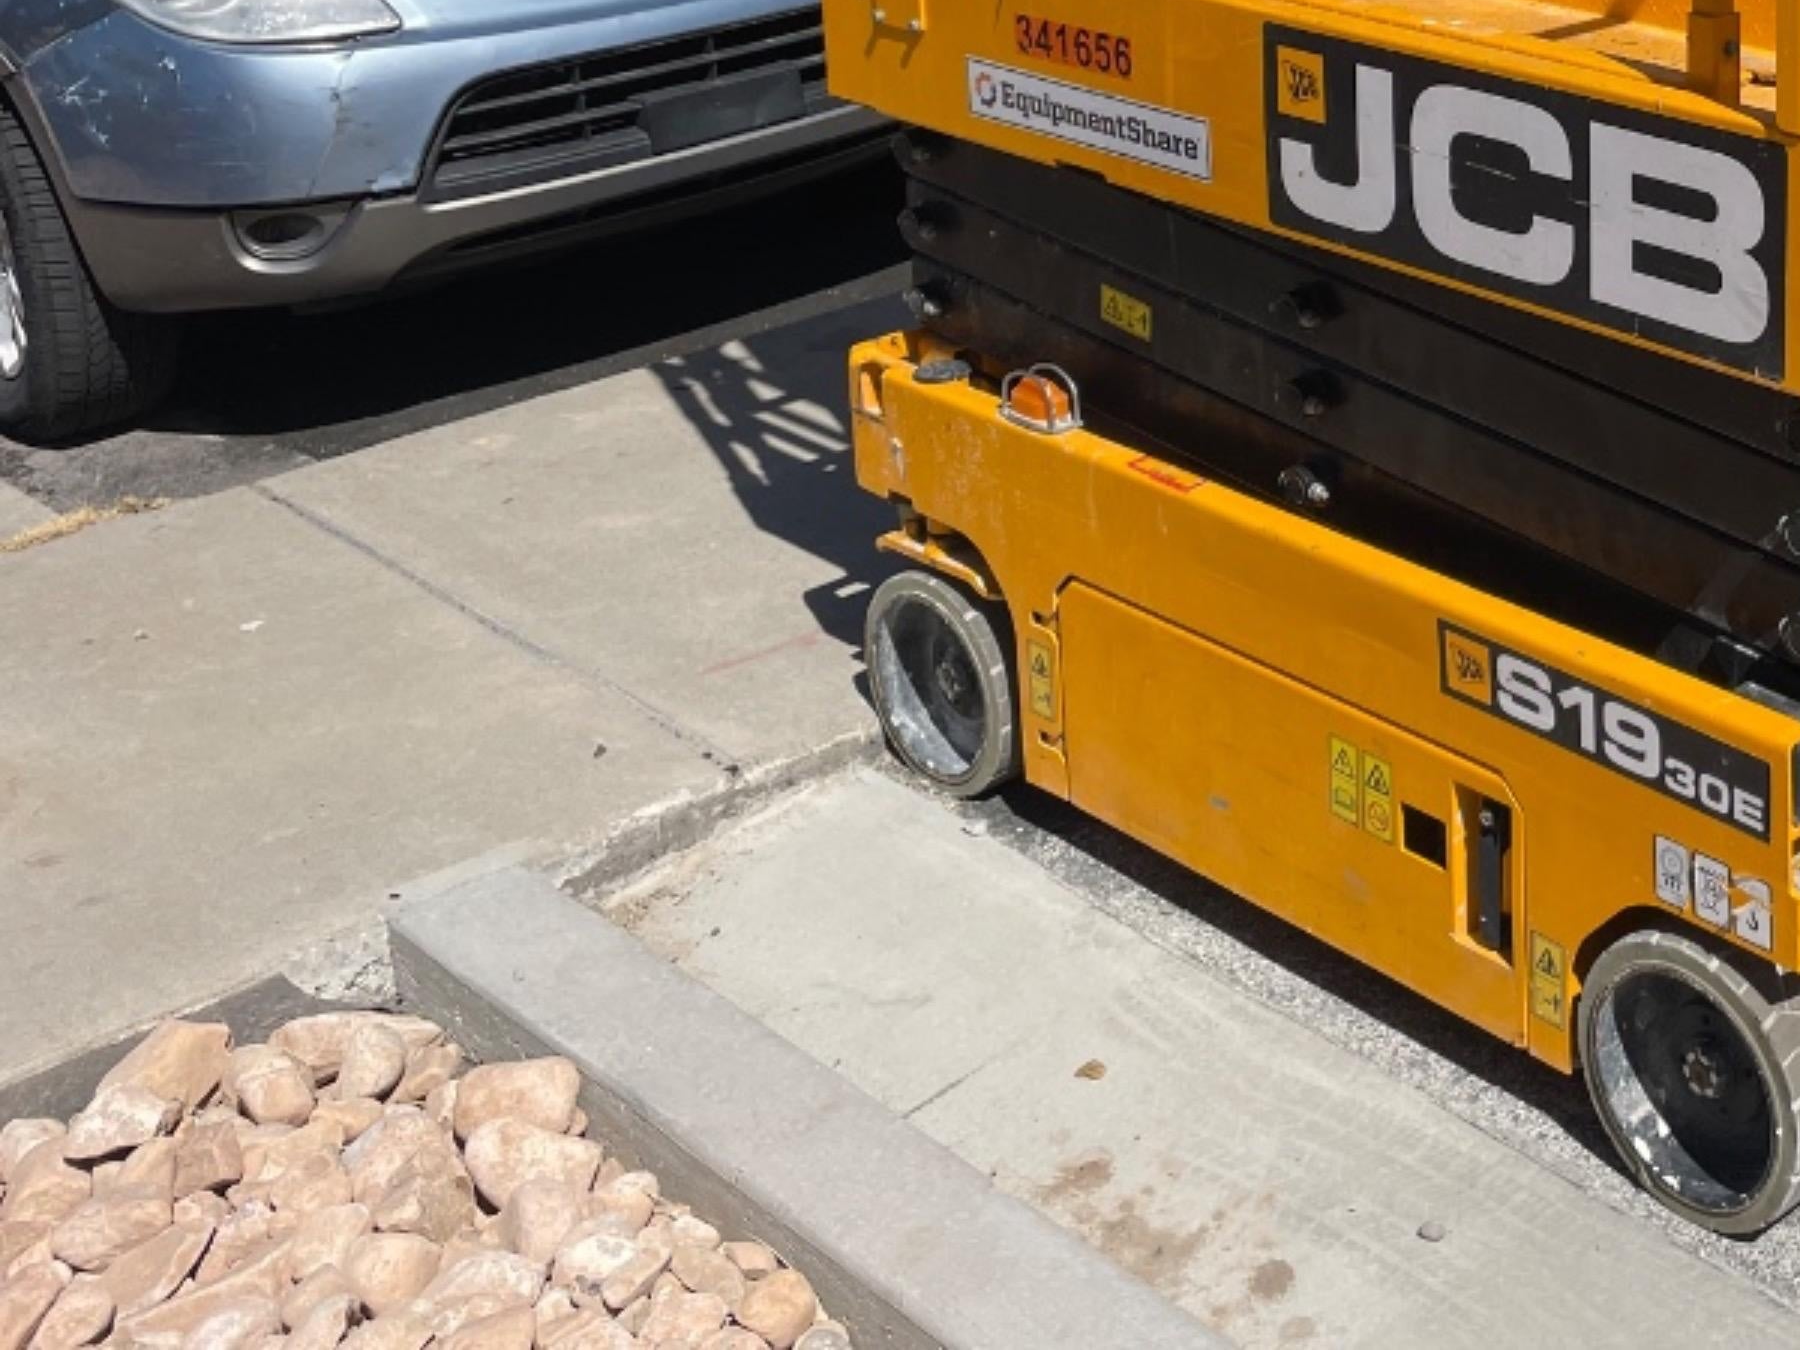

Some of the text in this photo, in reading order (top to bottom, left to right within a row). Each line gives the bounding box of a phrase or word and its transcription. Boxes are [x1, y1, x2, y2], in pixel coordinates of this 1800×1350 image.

[1015, 14, 1132, 77] 341656
[1001, 81, 1199, 160] EquipmentShare
[1280, 63, 1770, 344] JCB
